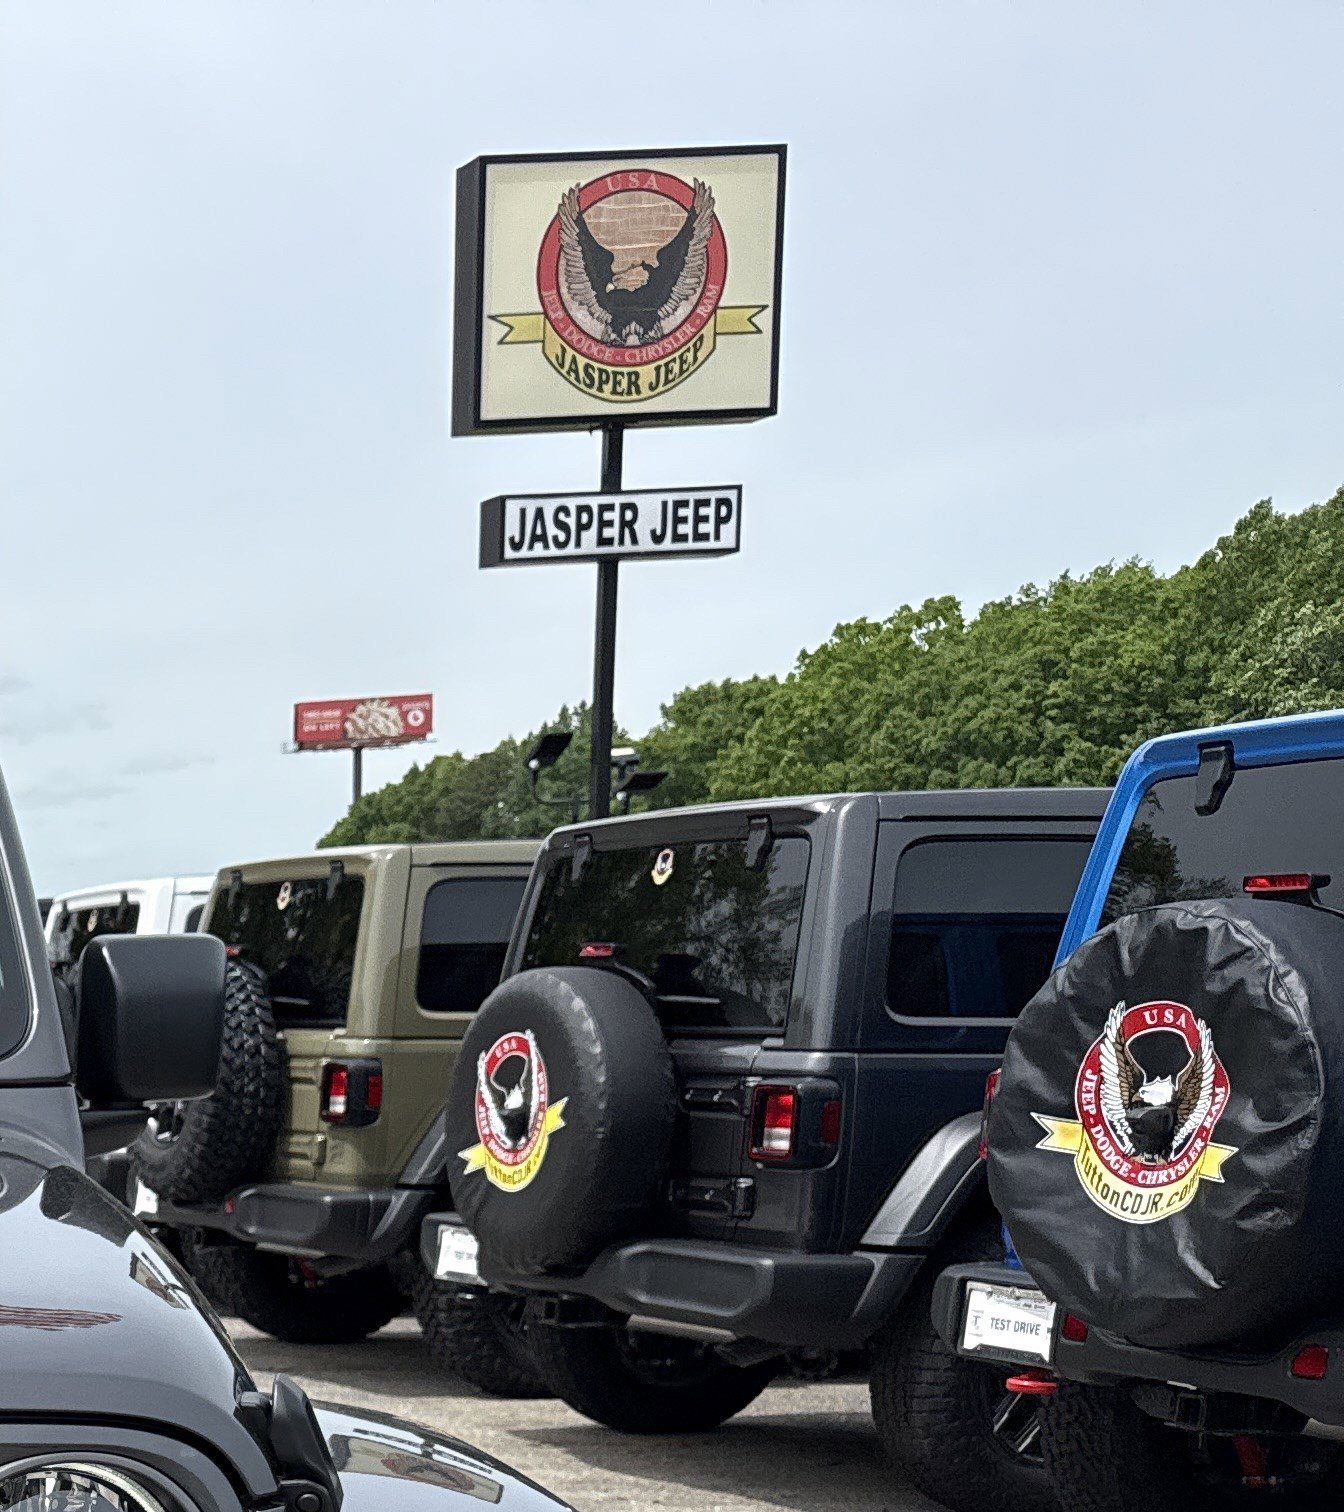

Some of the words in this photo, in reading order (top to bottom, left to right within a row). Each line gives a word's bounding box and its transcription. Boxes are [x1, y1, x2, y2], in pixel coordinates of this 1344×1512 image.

[606, 172, 660, 192] USA
[562, 325, 618, 360] DODGE
[624, 325, 697, 363] CHRYSLER
[554, 342, 642, 397] JASPER
[648, 332, 705, 393] JEEP
[508, 502, 639, 551] JASPER
[649, 497, 733, 546] JEEP
[1143, 1009, 1187, 1029] USA
[1081, 1068, 1098, 1115] JEEP
[1090, 1123, 1130, 1178] DODGE
[1137, 1139, 1206, 1185] CHRYSLER
[1203, 1085, 1226, 1128] RAM
[990, 1317, 1012, 1331] TEST
[1014, 1320, 1041, 1336] DRIVE
